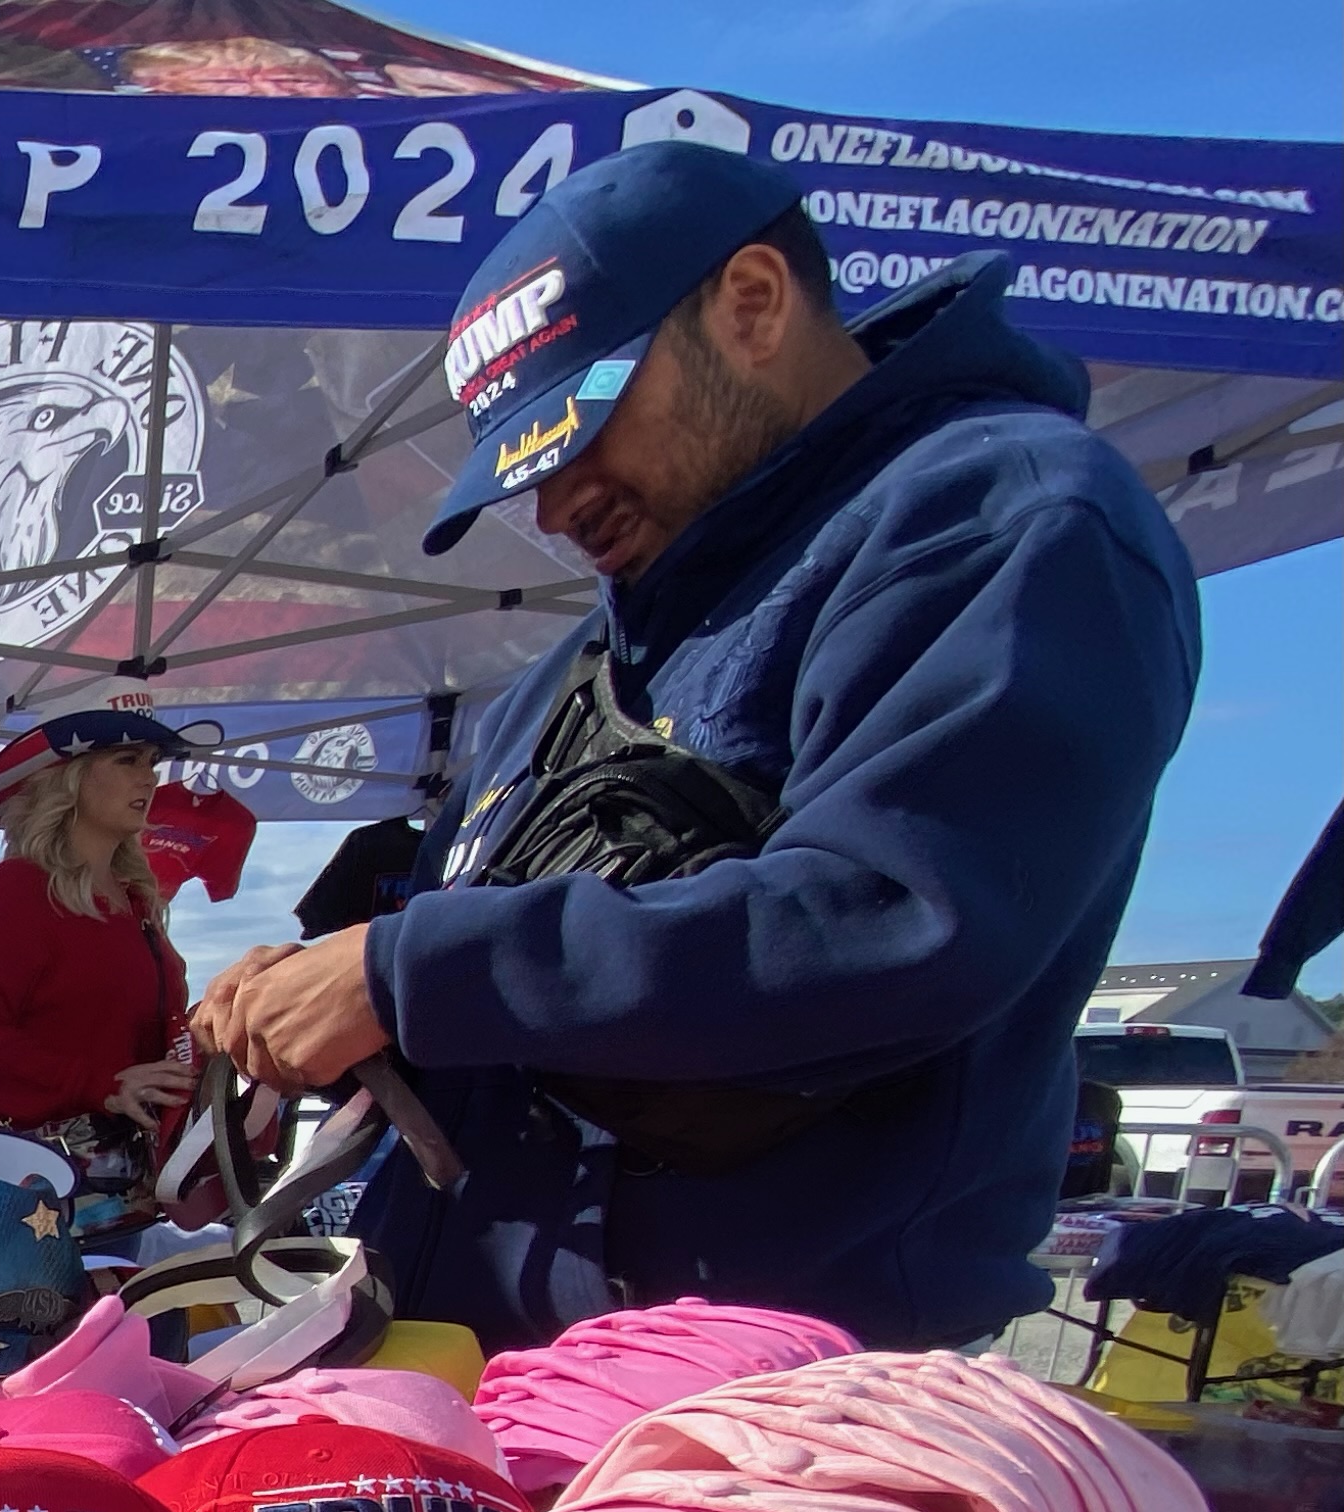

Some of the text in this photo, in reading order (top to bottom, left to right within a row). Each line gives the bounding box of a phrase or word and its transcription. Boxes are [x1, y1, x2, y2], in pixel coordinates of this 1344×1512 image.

[802, 190, 1269, 254] ONEFLAGONENATION
[444, 268, 566, 400] UMP
[469, 371, 516, 417] 2024
[107, 692, 154, 710] TRU
[1286, 1120, 1344, 1137] RA
